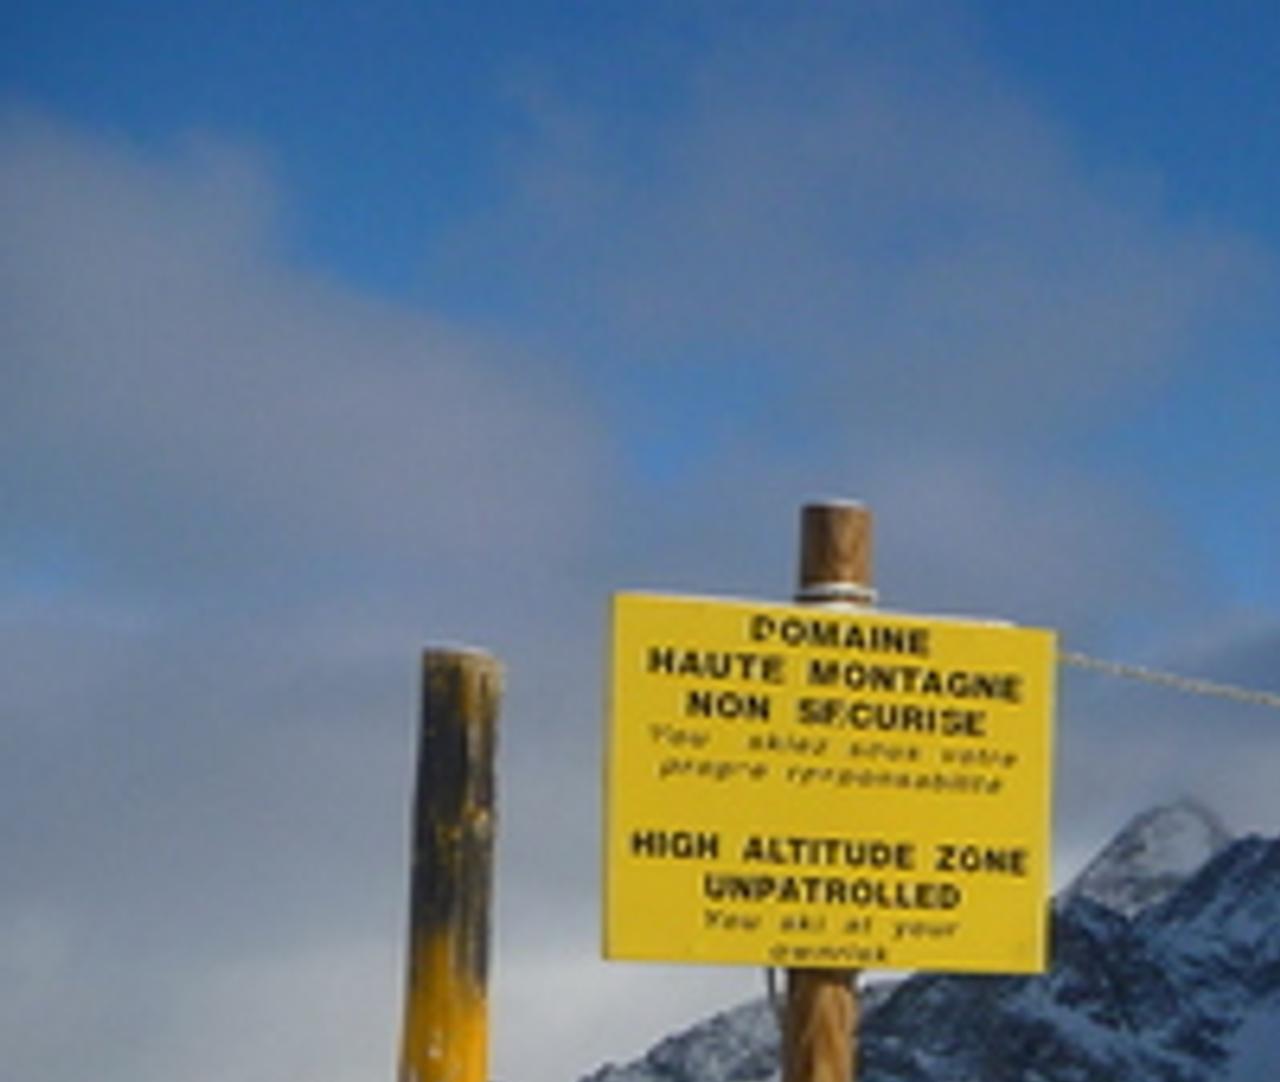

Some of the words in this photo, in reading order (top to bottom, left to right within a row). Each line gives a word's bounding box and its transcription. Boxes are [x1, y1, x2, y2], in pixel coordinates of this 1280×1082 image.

[751, 614, 930, 654] DOMAINE
[647, 647, 785, 684] HAUTE
[808, 659, 1024, 702] MONTAGNE
[686, 692, 770, 722] NON
[631, 831, 720, 860] HIGH
[743, 837, 916, 872] ALTITUDE
[935, 845, 1028, 877] ZONE
[704, 873, 961, 910] UNPATROLLED
